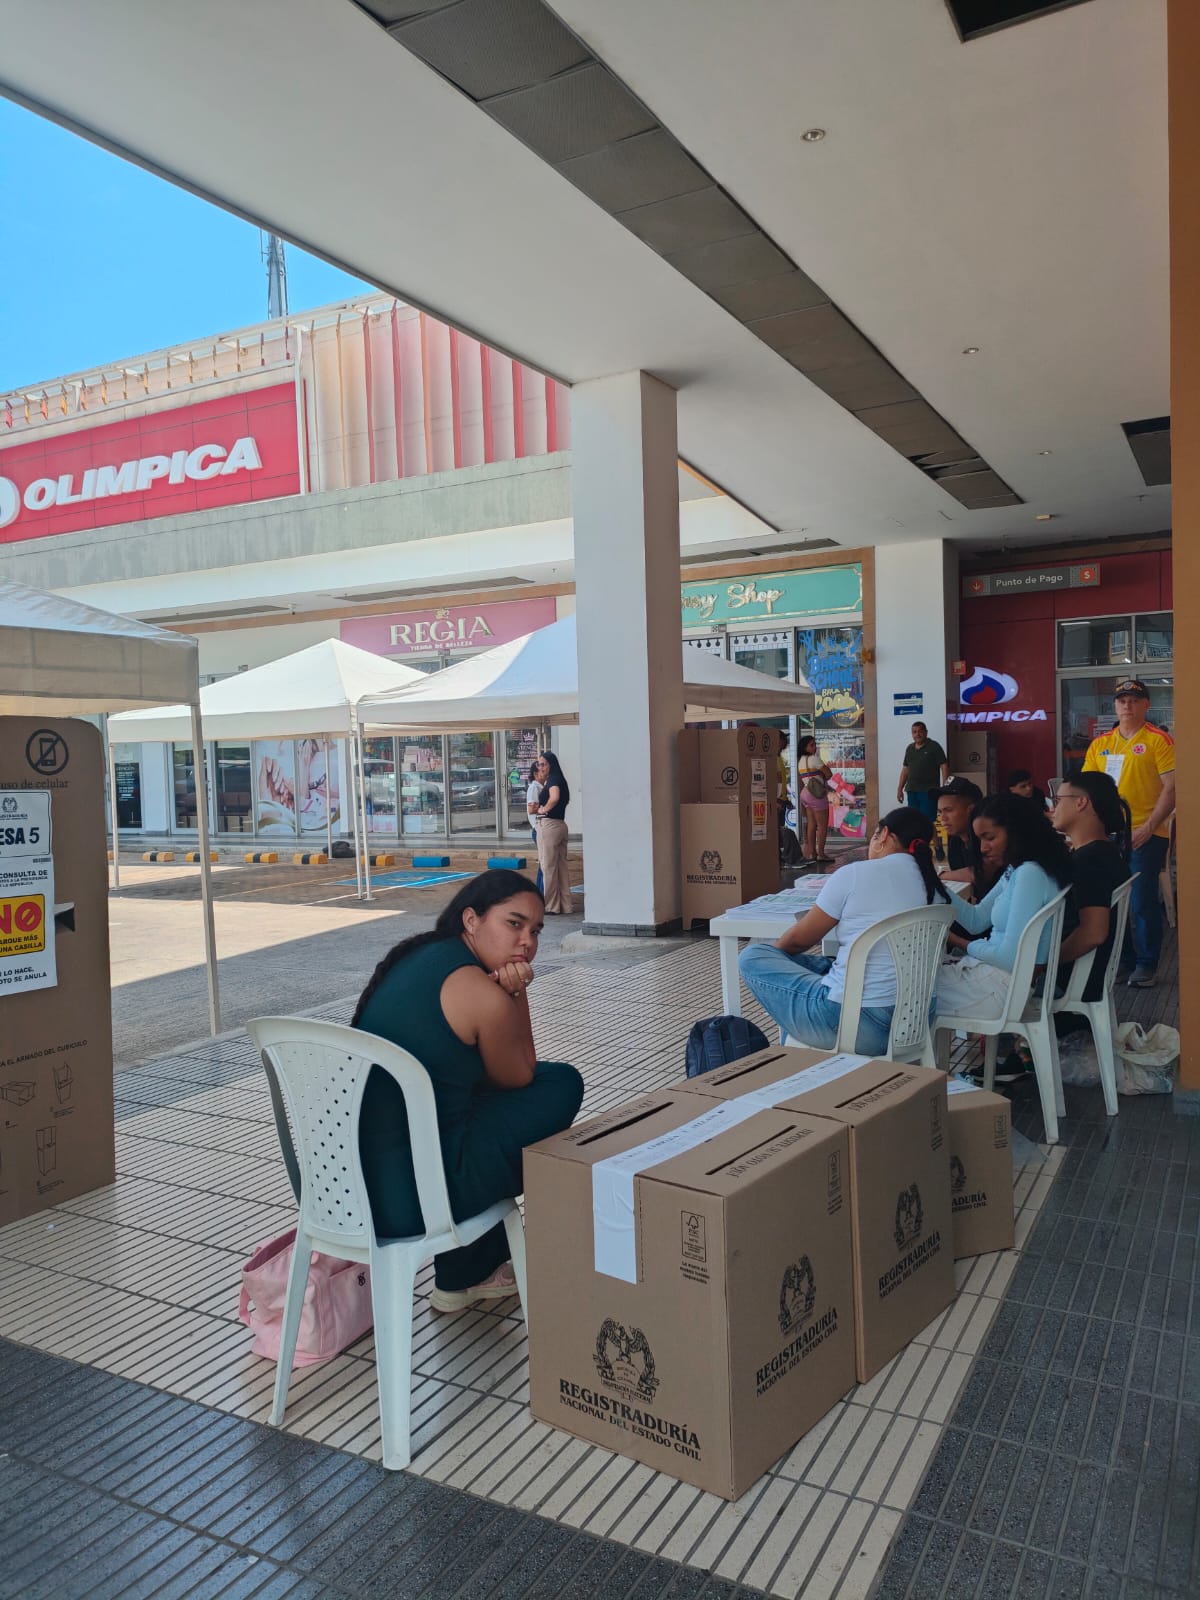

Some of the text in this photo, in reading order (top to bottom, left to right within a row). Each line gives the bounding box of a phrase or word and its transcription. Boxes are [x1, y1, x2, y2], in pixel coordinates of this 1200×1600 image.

[23, 437, 263, 510] OLIMPICA
[996, 578, 1022, 587] Punto
[1025, 576, 1037, 585] de
[1040, 574, 1063, 584] Pago
[727, 582, 784, 614] Shop
[390, 616, 495, 646] REGIA
[29, 827, 40, 844] 5
[14, 941, 43, 951] CASILLA
[3, 969, 13, 977] LO
[14, 975, 23, 983] SE
[24, 971, 47, 981] ANULA
[879, 1229, 941, 1290] REGISTRADURÍA
[756, 1306, 838, 1386] REGISTRADURÍA
[756, 1322, 838, 1397] NACIONAL DEL ESTADO CIVIL
[560, 1378, 701, 1450] REGISTRADURÍA
[560, 1394, 702, 1461] NACIONAL DEL ESTADO CIVIL
